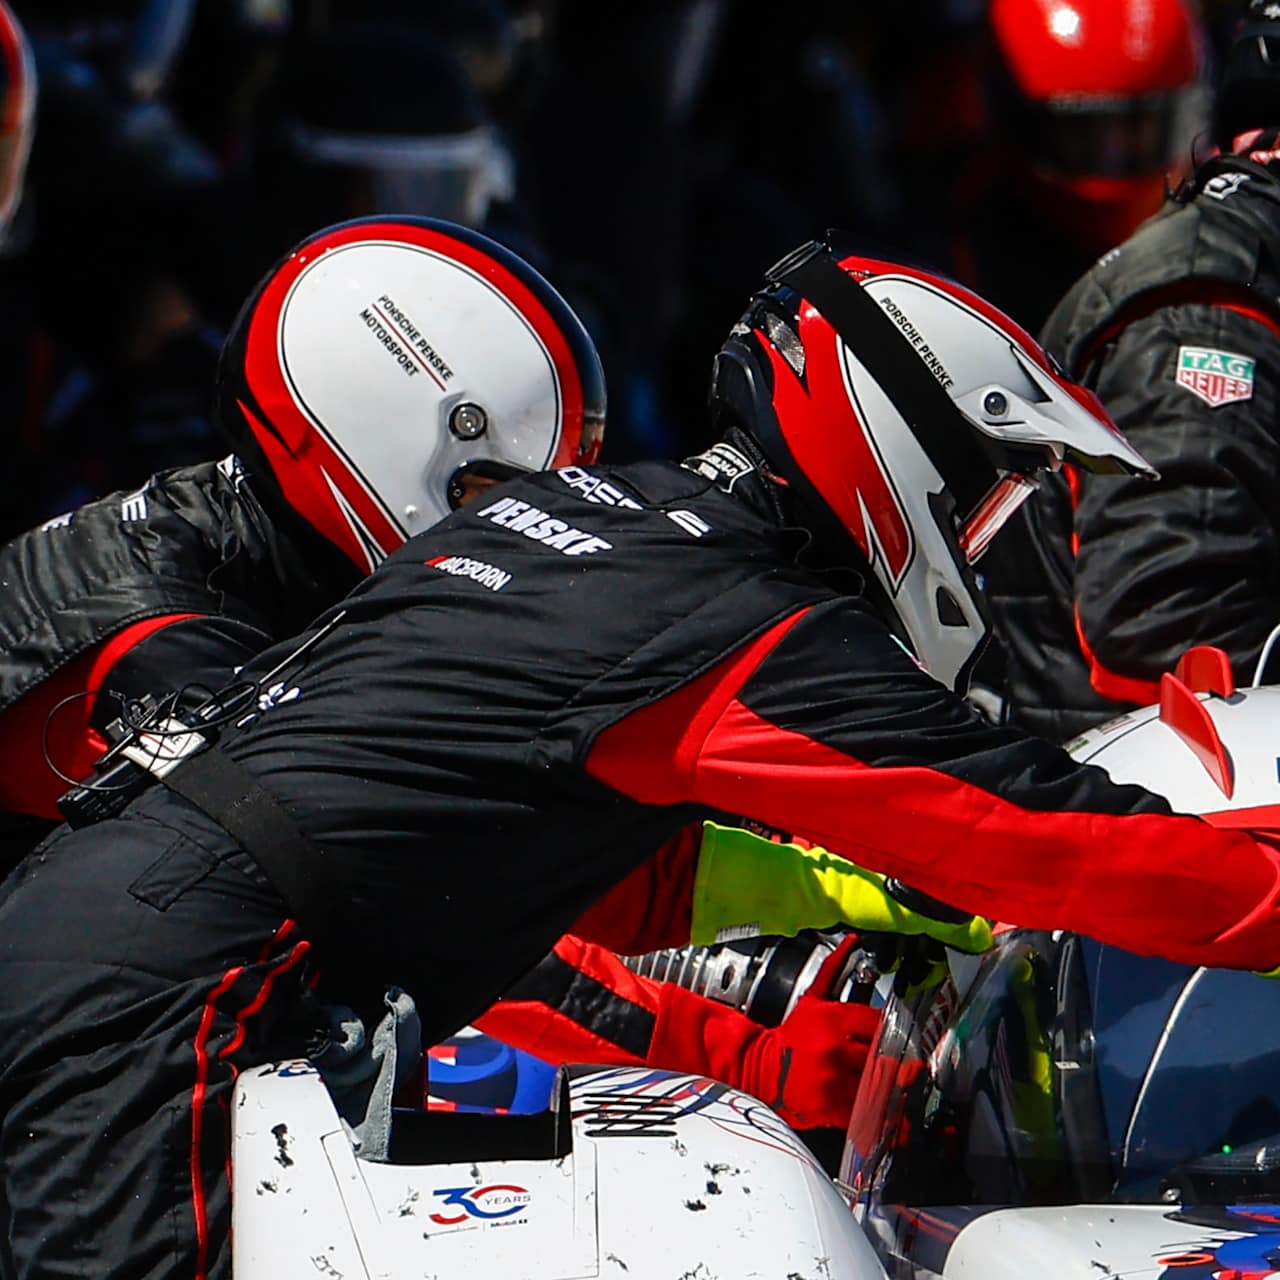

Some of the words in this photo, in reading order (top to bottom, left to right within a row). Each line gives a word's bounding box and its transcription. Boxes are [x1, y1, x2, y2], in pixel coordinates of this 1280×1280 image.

[359, 308, 420, 377] MOTORSPORT
[377, 294, 421, 342] PORSCHE
[415, 339, 455, 382] PENSKE
[880, 297, 924, 347] PORSCHE
[918, 344, 955, 390] PENSKE
[1184, 351, 1249, 377] TAG
[1181, 371, 1250, 403] HEUER
[476, 496, 614, 557] PENSKE
[484, 1194, 532, 1206] YEARS
